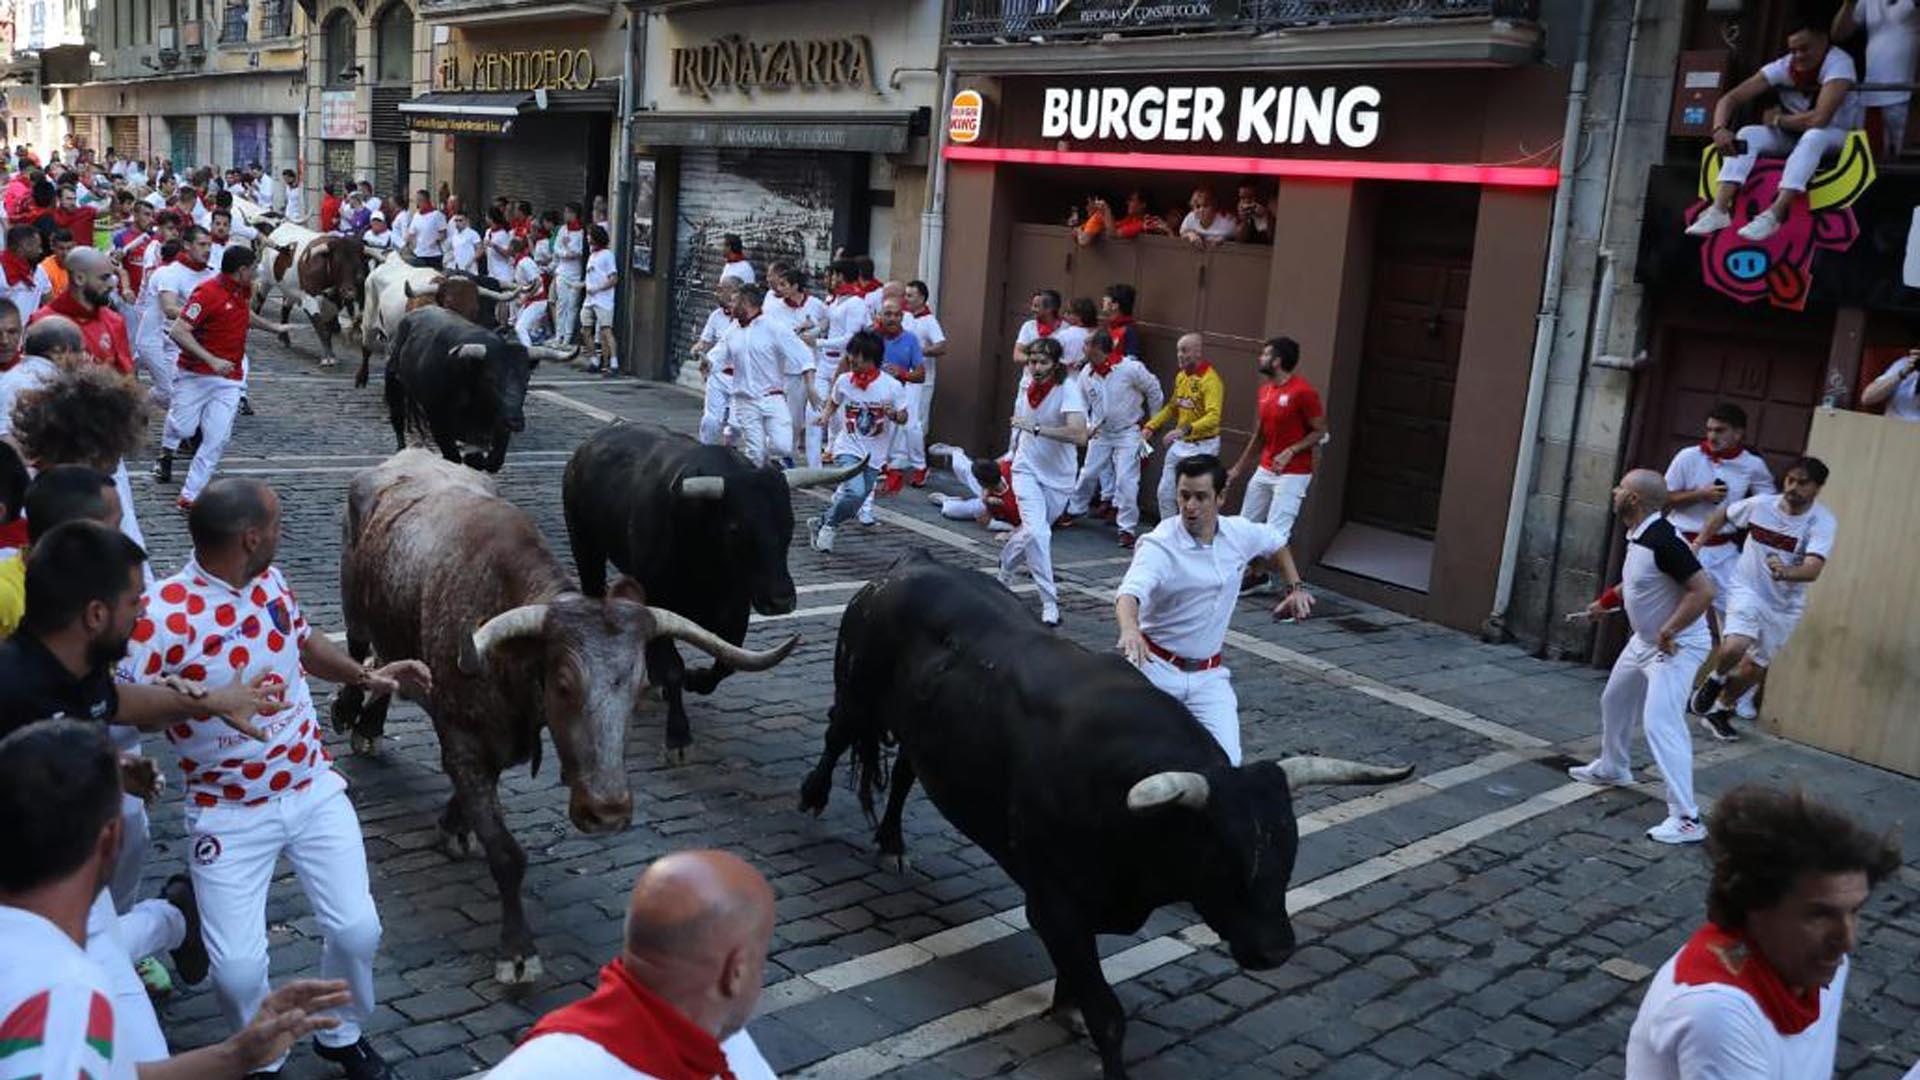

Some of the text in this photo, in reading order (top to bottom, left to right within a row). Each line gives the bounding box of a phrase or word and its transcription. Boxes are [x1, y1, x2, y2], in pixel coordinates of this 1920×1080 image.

[472, 49, 593, 91] MENTIDERO
[671, 33, 883, 98] IRUÑAZARRA
[950, 118, 978, 131] KING
[1042, 86, 1381, 148] BURGER KING
